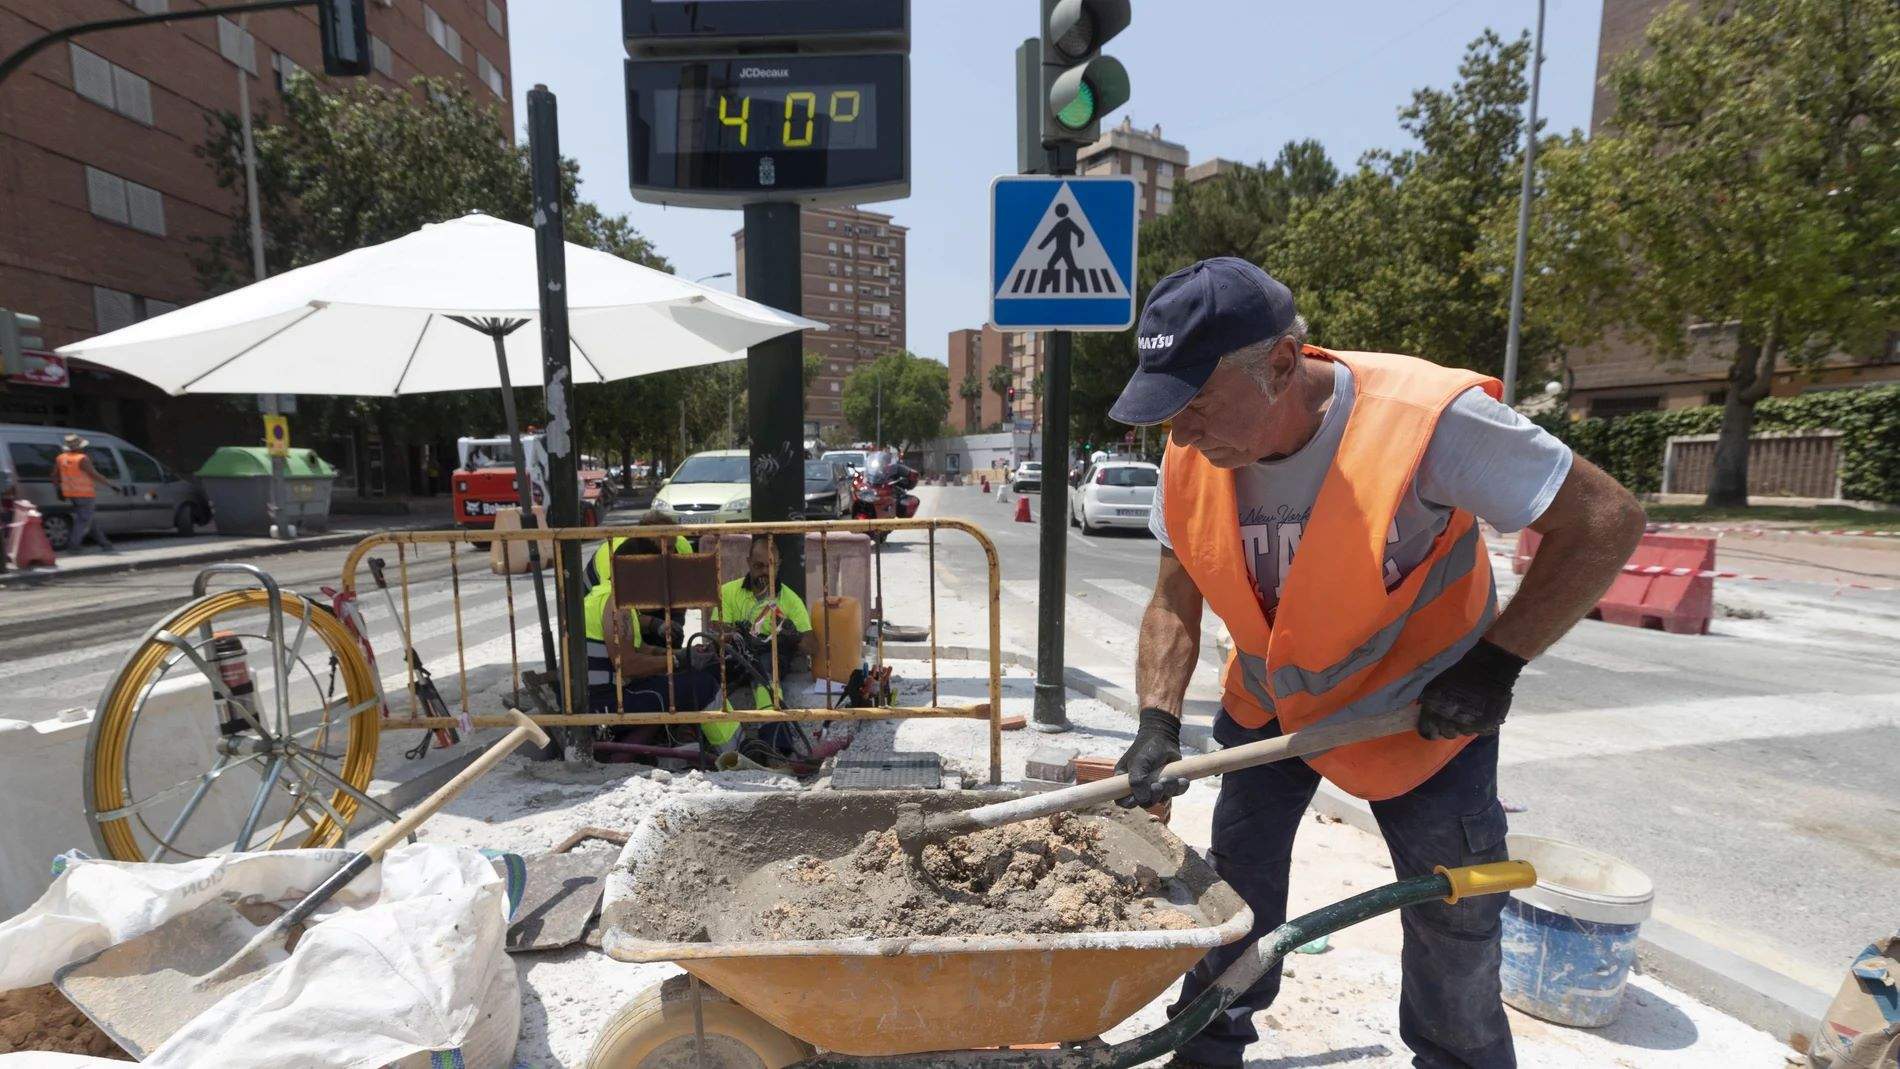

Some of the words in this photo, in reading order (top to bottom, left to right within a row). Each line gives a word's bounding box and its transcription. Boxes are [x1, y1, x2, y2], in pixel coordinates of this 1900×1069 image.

[738, 67, 789, 78] JCDecaux
[1240, 505, 1278, 523] New
[1276, 504, 1313, 530] York
